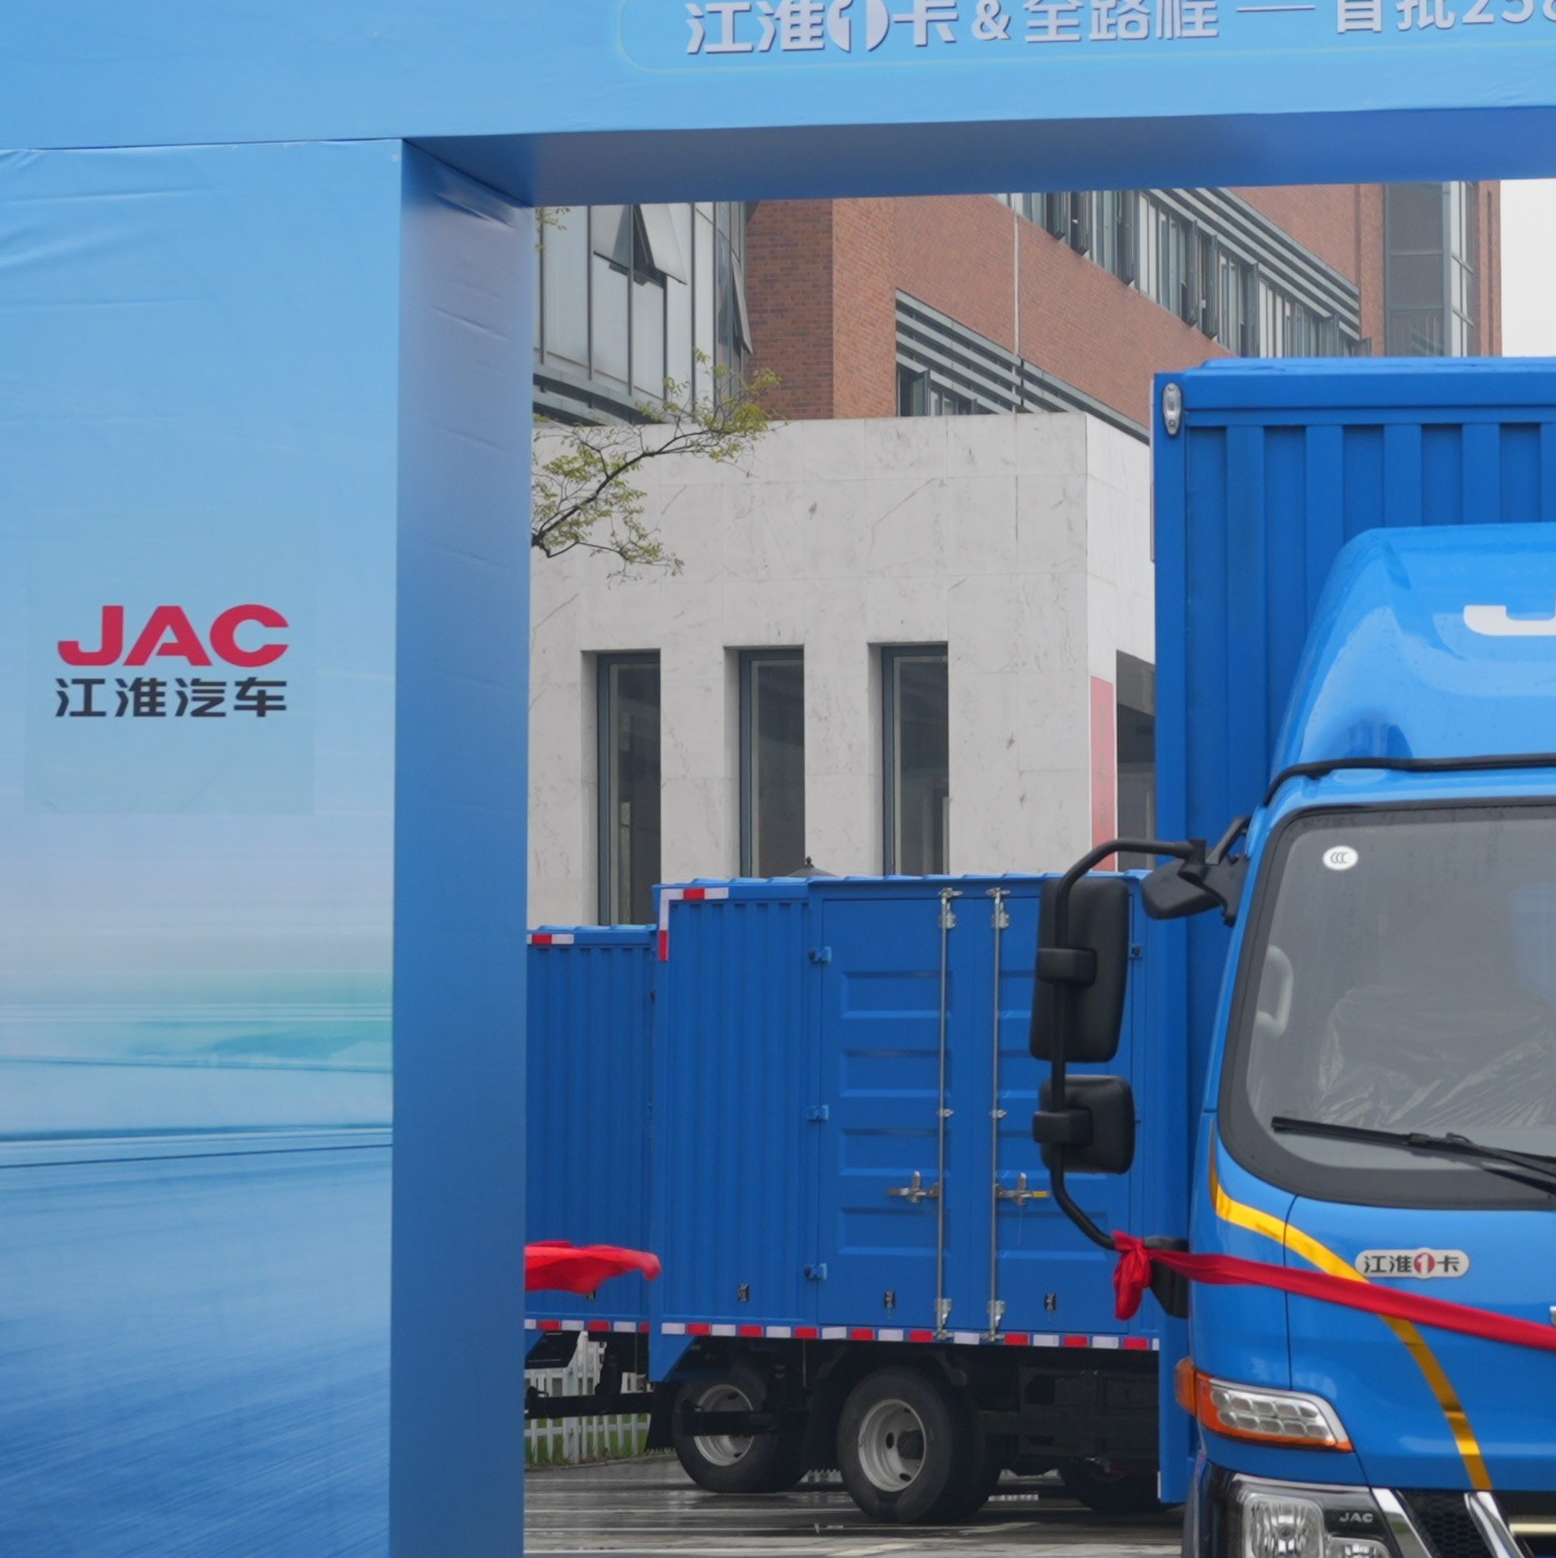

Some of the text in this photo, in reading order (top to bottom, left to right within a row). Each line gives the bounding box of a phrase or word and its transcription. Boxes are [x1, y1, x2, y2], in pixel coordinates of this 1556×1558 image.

[57, 604, 290, 668] JAC
[55, 677, 287, 718] 江淮汽车
[1364, 1252, 1460, 1275] 江淮1卡
[1339, 1512, 1374, 1523] JAC
